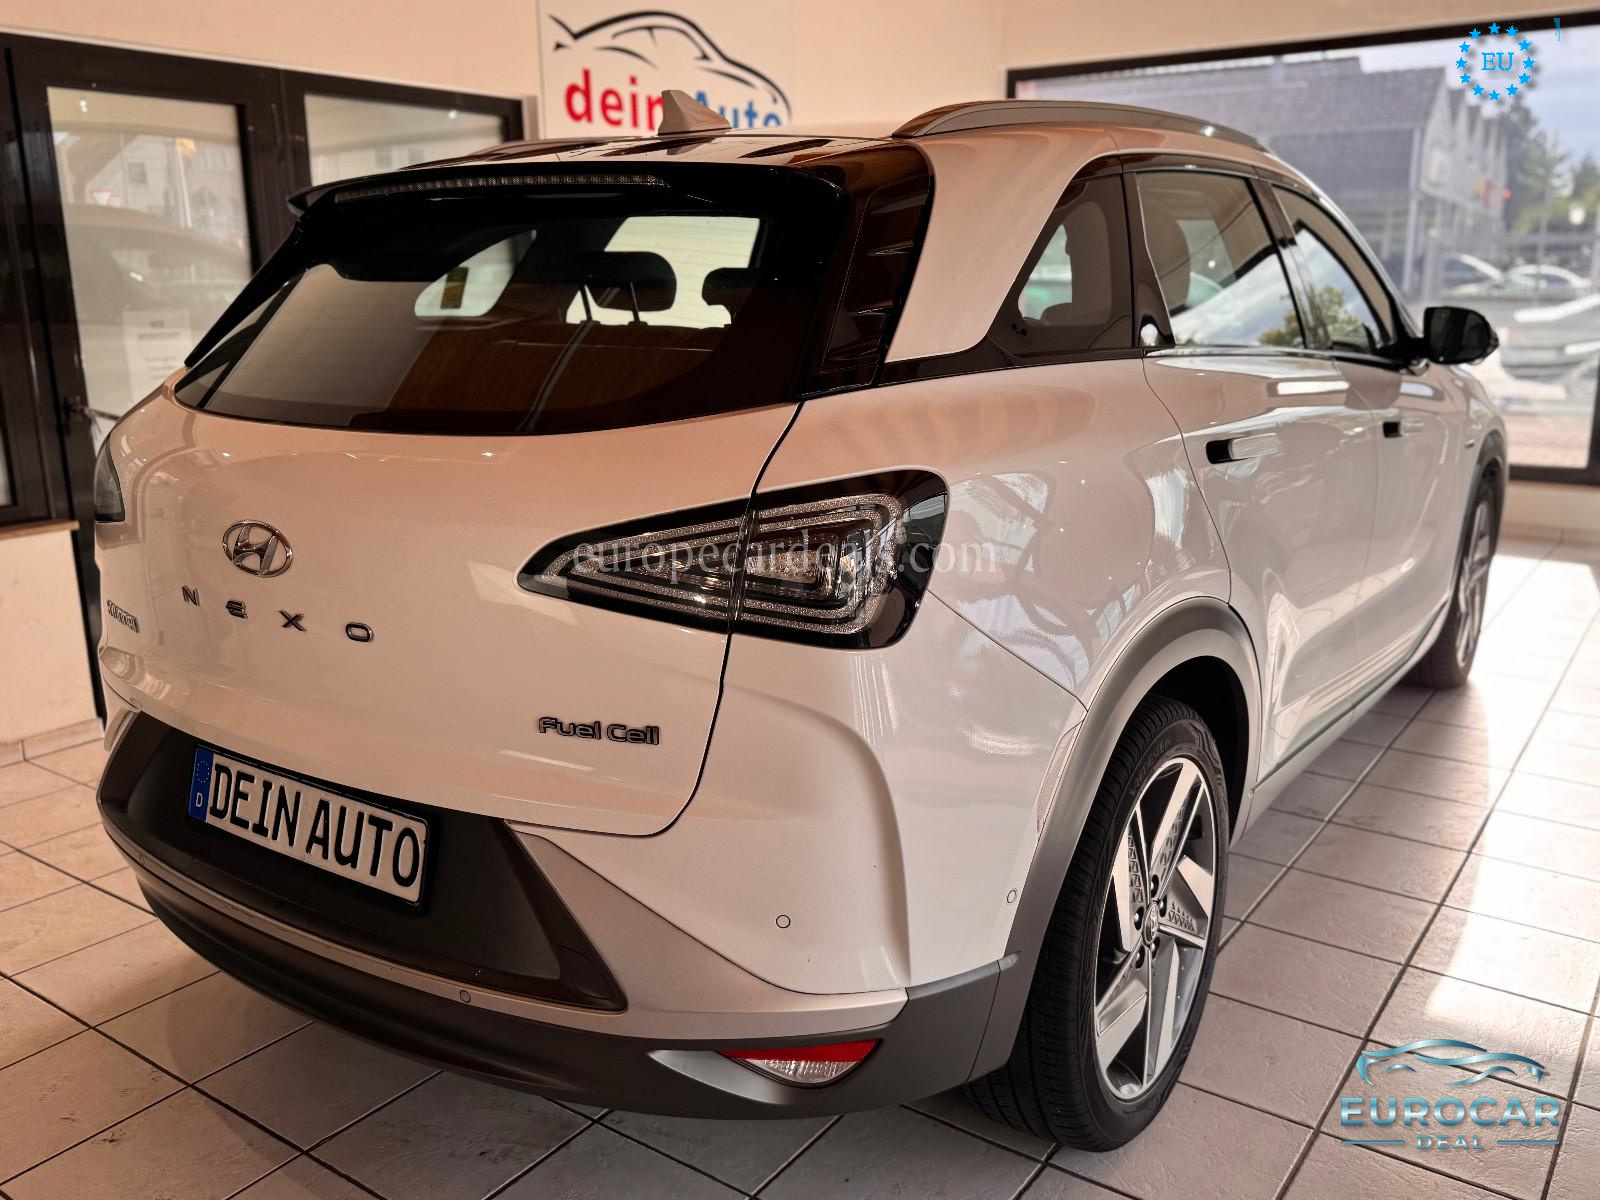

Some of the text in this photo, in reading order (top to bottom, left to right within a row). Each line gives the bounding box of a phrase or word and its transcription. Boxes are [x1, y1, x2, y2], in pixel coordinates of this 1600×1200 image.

[182, 585, 374, 642] NEXO
[538, 716, 660, 746] Fuel Cell
[209, 763, 421, 888] DEIN AUTO
